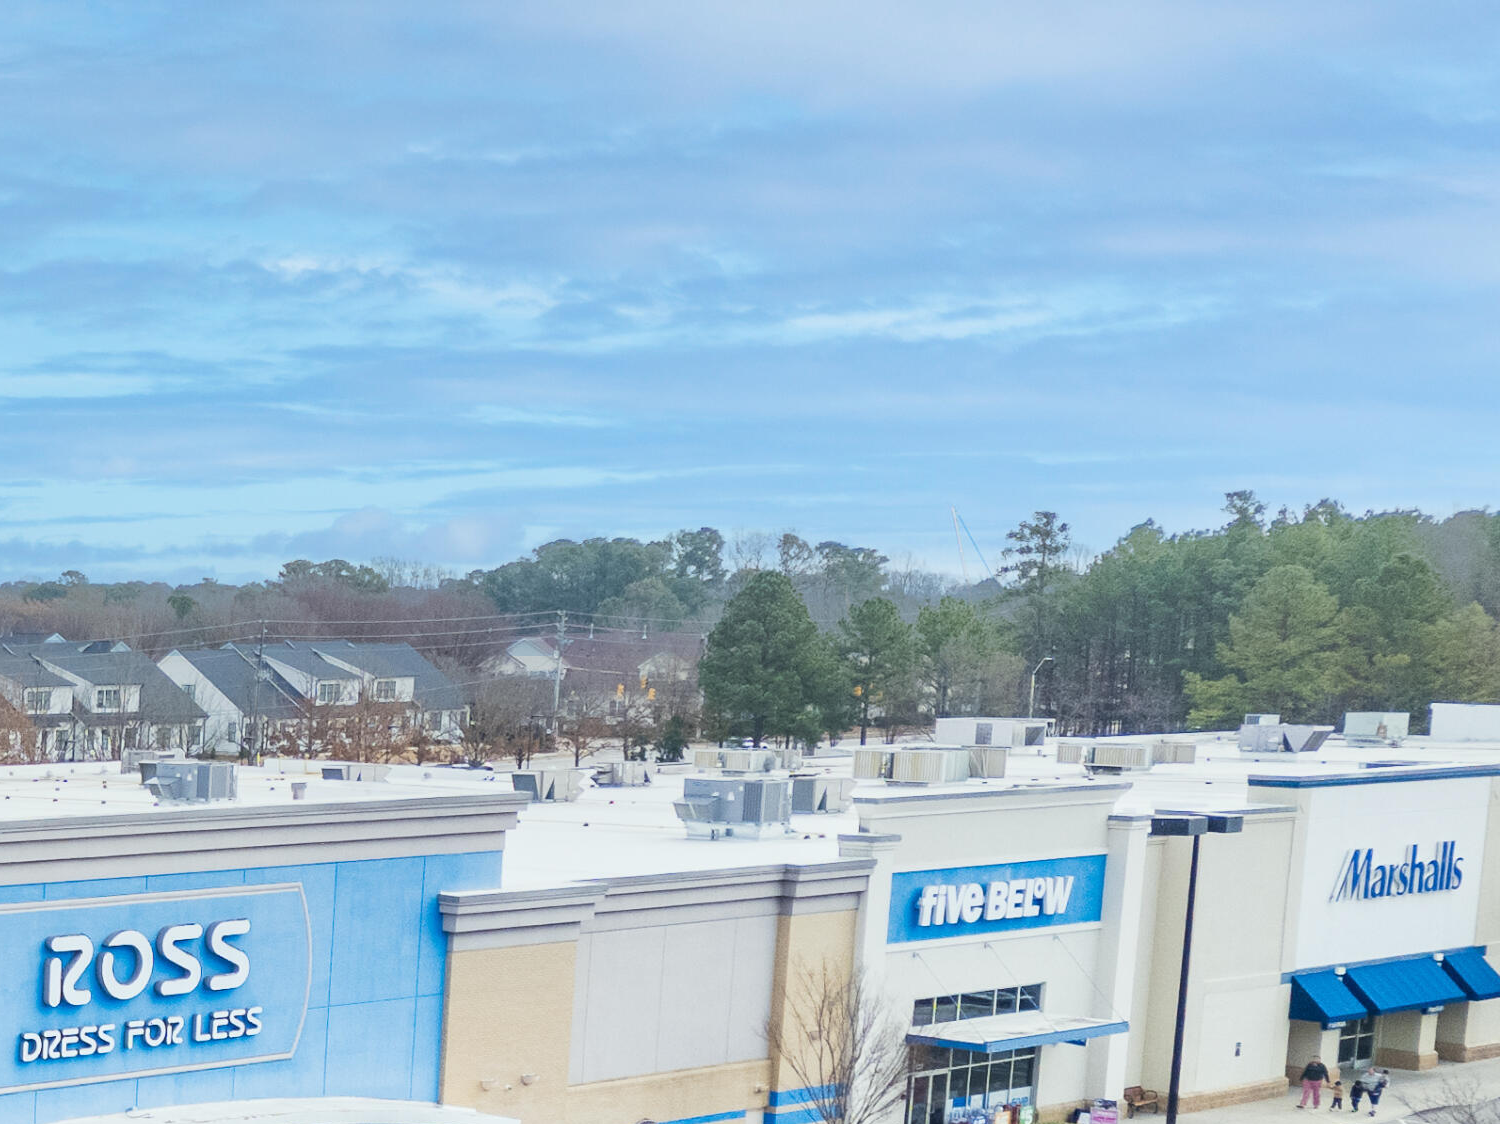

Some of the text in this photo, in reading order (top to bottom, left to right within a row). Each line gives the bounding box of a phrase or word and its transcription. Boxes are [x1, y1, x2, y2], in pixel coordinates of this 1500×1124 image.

[1334, 841, 1464, 902] Marshalls
[917, 883, 985, 927] five
[43, 918, 251, 1008] ROSS
[20, 1006, 263, 1063] DRESS FOR LESS
